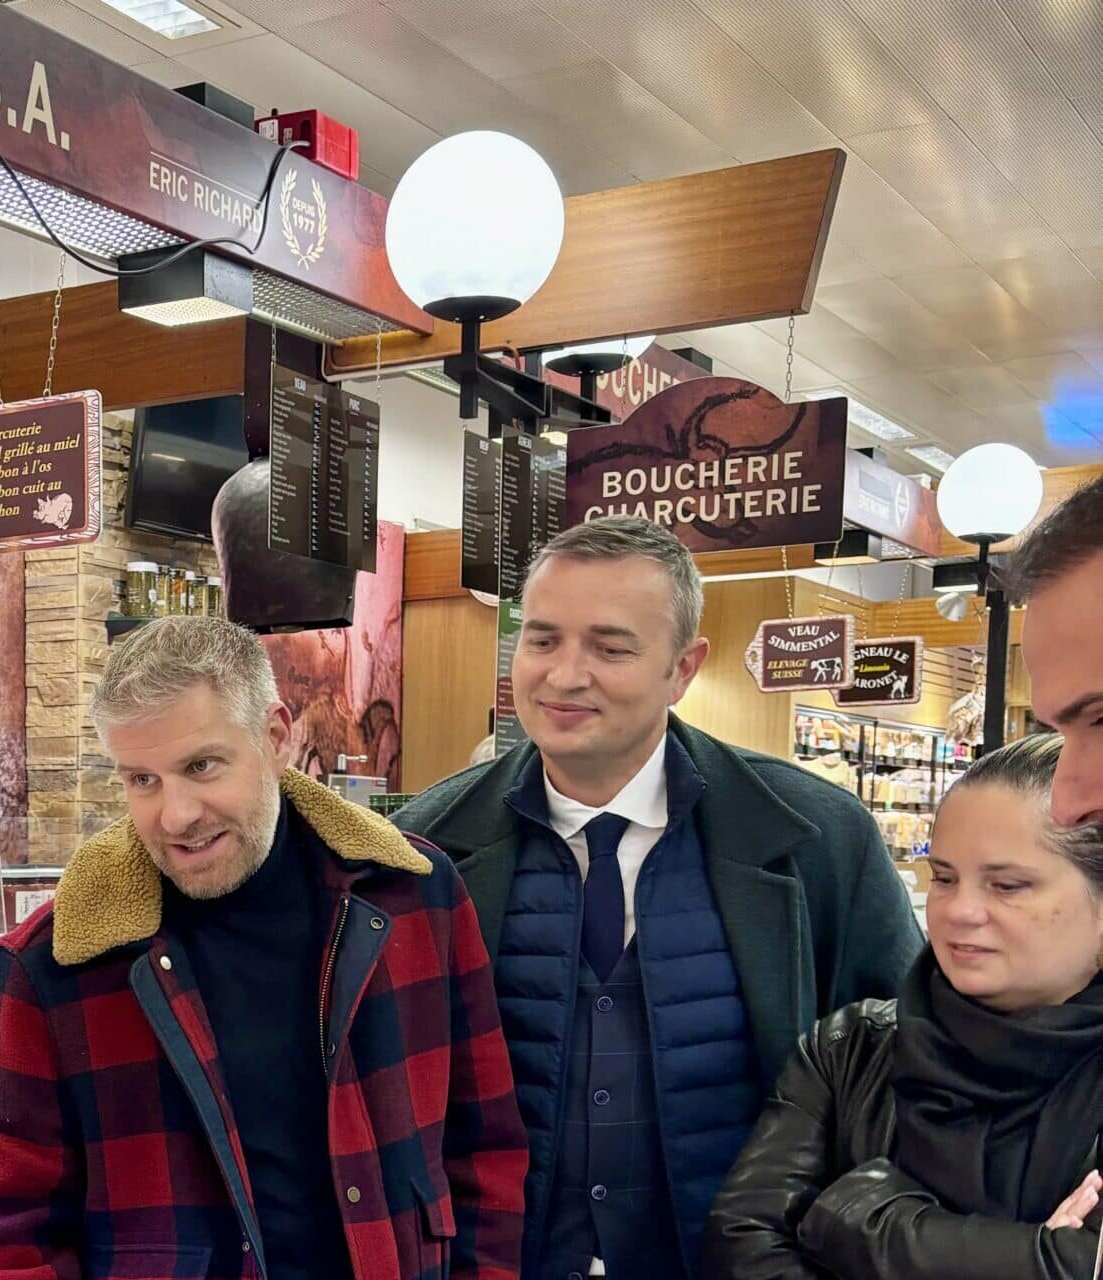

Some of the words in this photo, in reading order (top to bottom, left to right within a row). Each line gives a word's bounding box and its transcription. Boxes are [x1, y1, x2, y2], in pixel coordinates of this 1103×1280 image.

[149, 161, 188, 202] ERIC
[194, 182, 263, 234] RICHARD
[293, 197, 315, 216] DEPUIS
[293, 213, 315, 233] 1977
[3, 441, 35, 463] grillé
[36, 443, 50, 453] au
[53, 433, 80, 450] miel
[22, 462, 28, 475] à
[31, 460, 52, 474] l'os
[602, 451, 803, 498] BOUCHERIE
[22, 480, 45, 494] cuit
[47, 480, 62, 491] au
[788, 625, 820, 637] VEAU
[768, 631, 840, 652] SIMMENTAL
[853, 647, 892, 661] GNEAU
[893, 649, 910, 664] LE
[772, 670, 803, 679] SUISSE
[854, 671, 898, 689] ARONET
